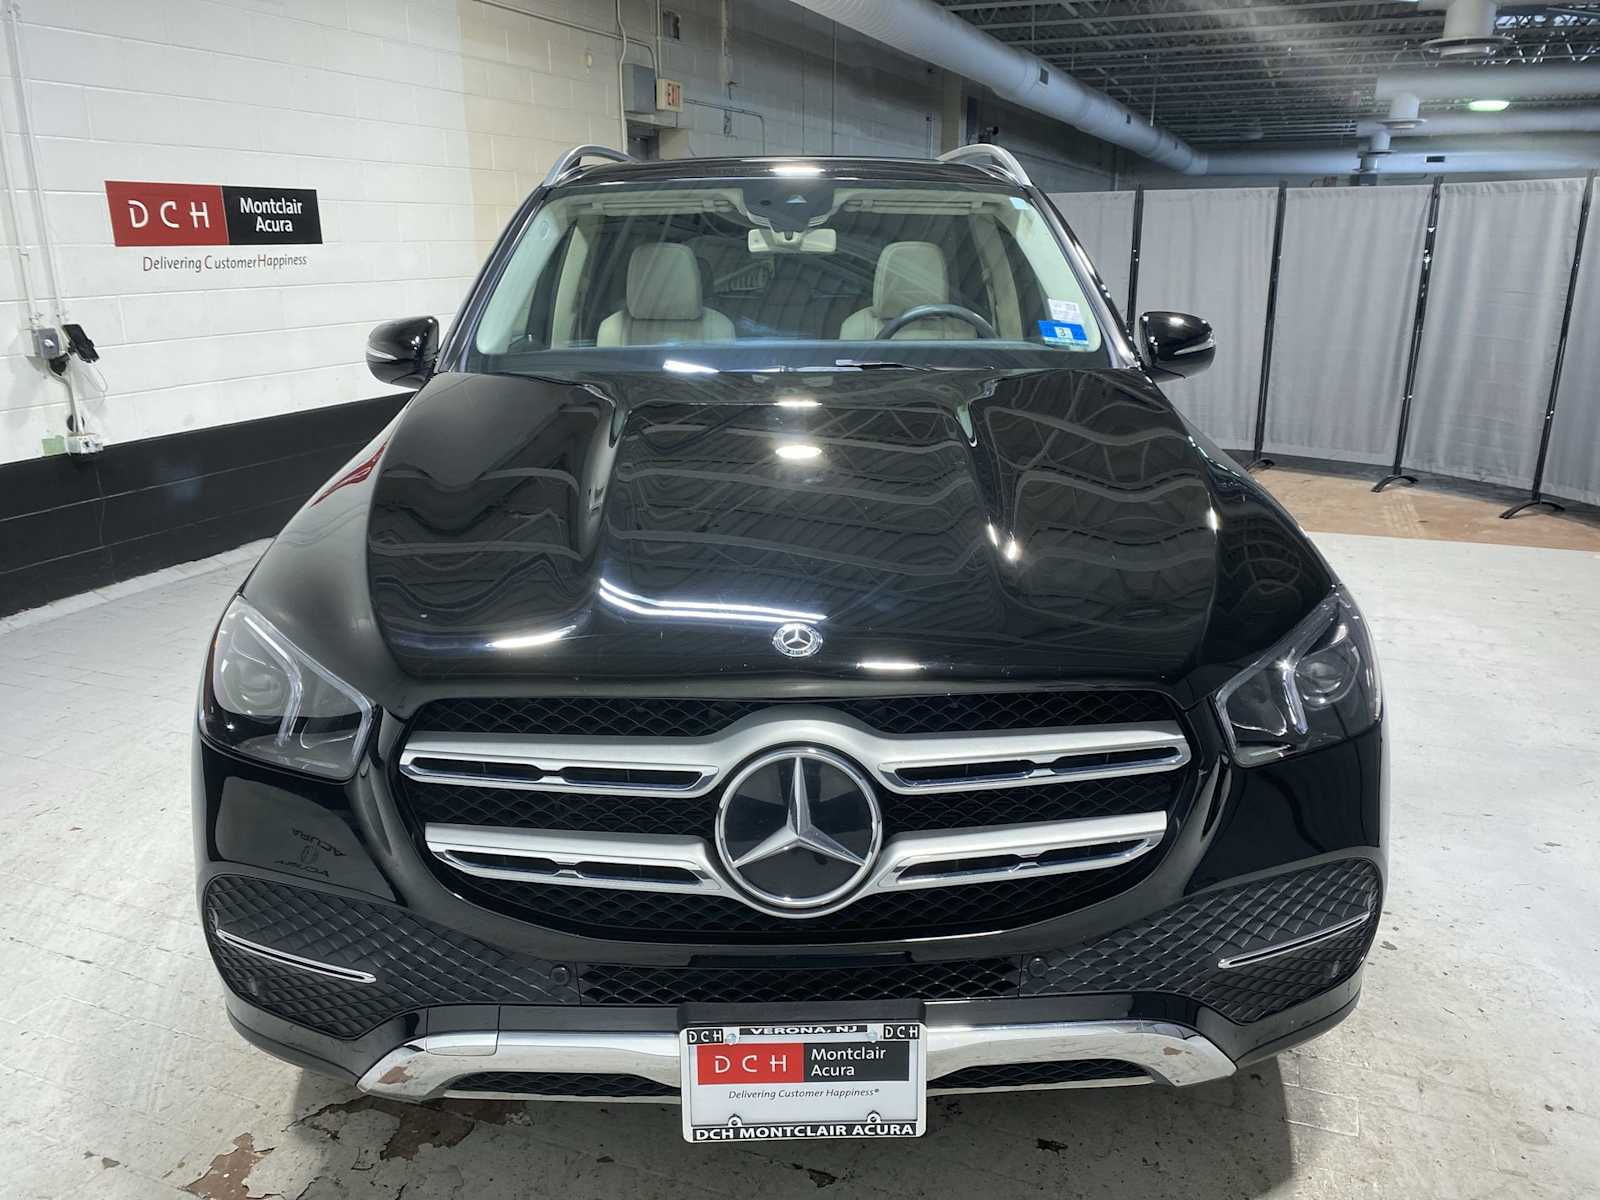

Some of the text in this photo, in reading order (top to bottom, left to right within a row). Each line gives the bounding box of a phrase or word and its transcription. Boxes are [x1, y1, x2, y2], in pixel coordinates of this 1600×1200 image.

[239, 196, 303, 215] Montclair
[127, 199, 210, 230] DCH
[255, 217, 294, 233] Acura
[143, 256, 202, 273] Delivering
[688, 1029, 723, 1044] DCH
[835, 1025, 858, 1033] NJ
[884, 1025, 919, 1039] DCH
[810, 1046, 887, 1061] Montclair
[714, 1054, 788, 1073] DCH
[810, 1064, 856, 1078] Acura
[728, 1089, 776, 1101] Delivering
[778, 1087, 824, 1098] Customer
[695, 1123, 914, 1141] DCH MONTCLAIR ACURA
